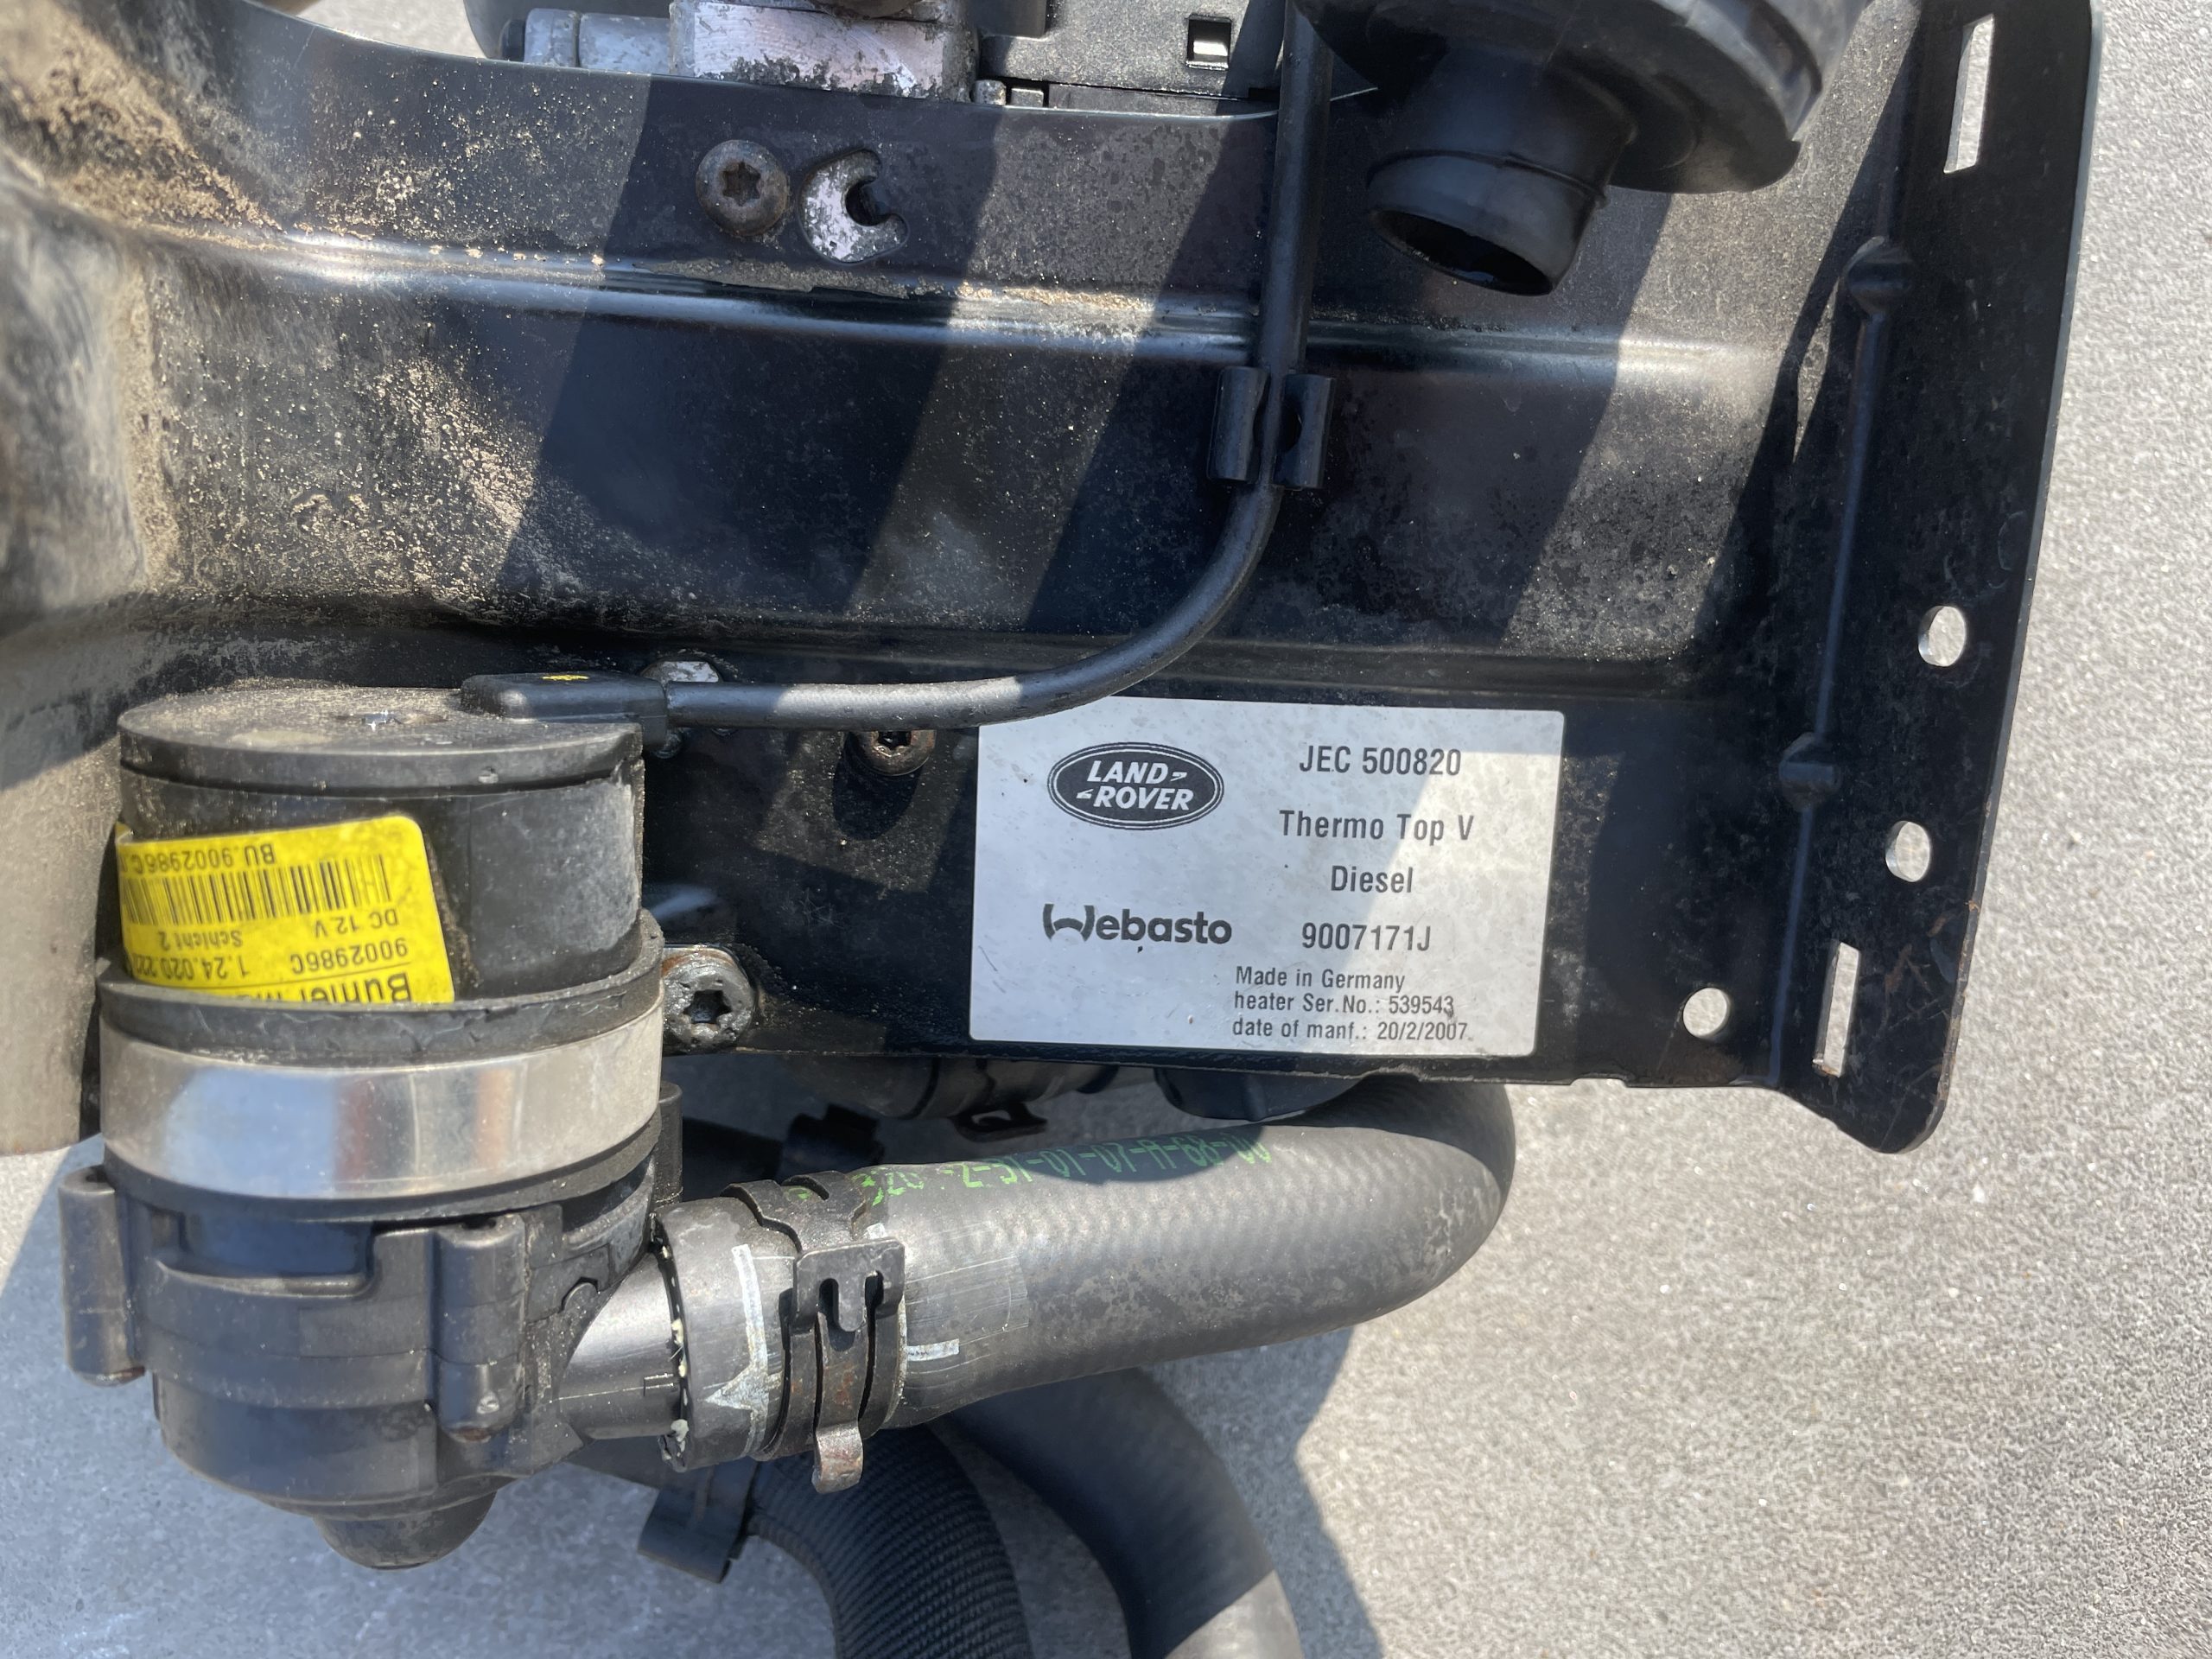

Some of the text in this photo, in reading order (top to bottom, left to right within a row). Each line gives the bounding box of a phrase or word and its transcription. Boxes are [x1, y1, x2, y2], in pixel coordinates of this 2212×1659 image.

[1299, 745, 1461, 776] JEC 500820
[1280, 810, 1474, 846] Thermo Top V
[1331, 865, 1414, 893] Diesel
[315, 908, 399, 938] DC 12 V
[1042, 903, 1232, 944] Webasto
[1301, 922, 1432, 951] 9007171J
[158, 930, 244, 950] Schicht 2
[290, 937, 409, 975] 9002986C
[1236, 966, 1405, 993] Made in Germany
[1234, 991, 1294, 1011] heater
[1389, 995, 1454, 1016] 539543
[1232, 1015, 1273, 1036] date
[1281, 1020, 1299, 1037] of
